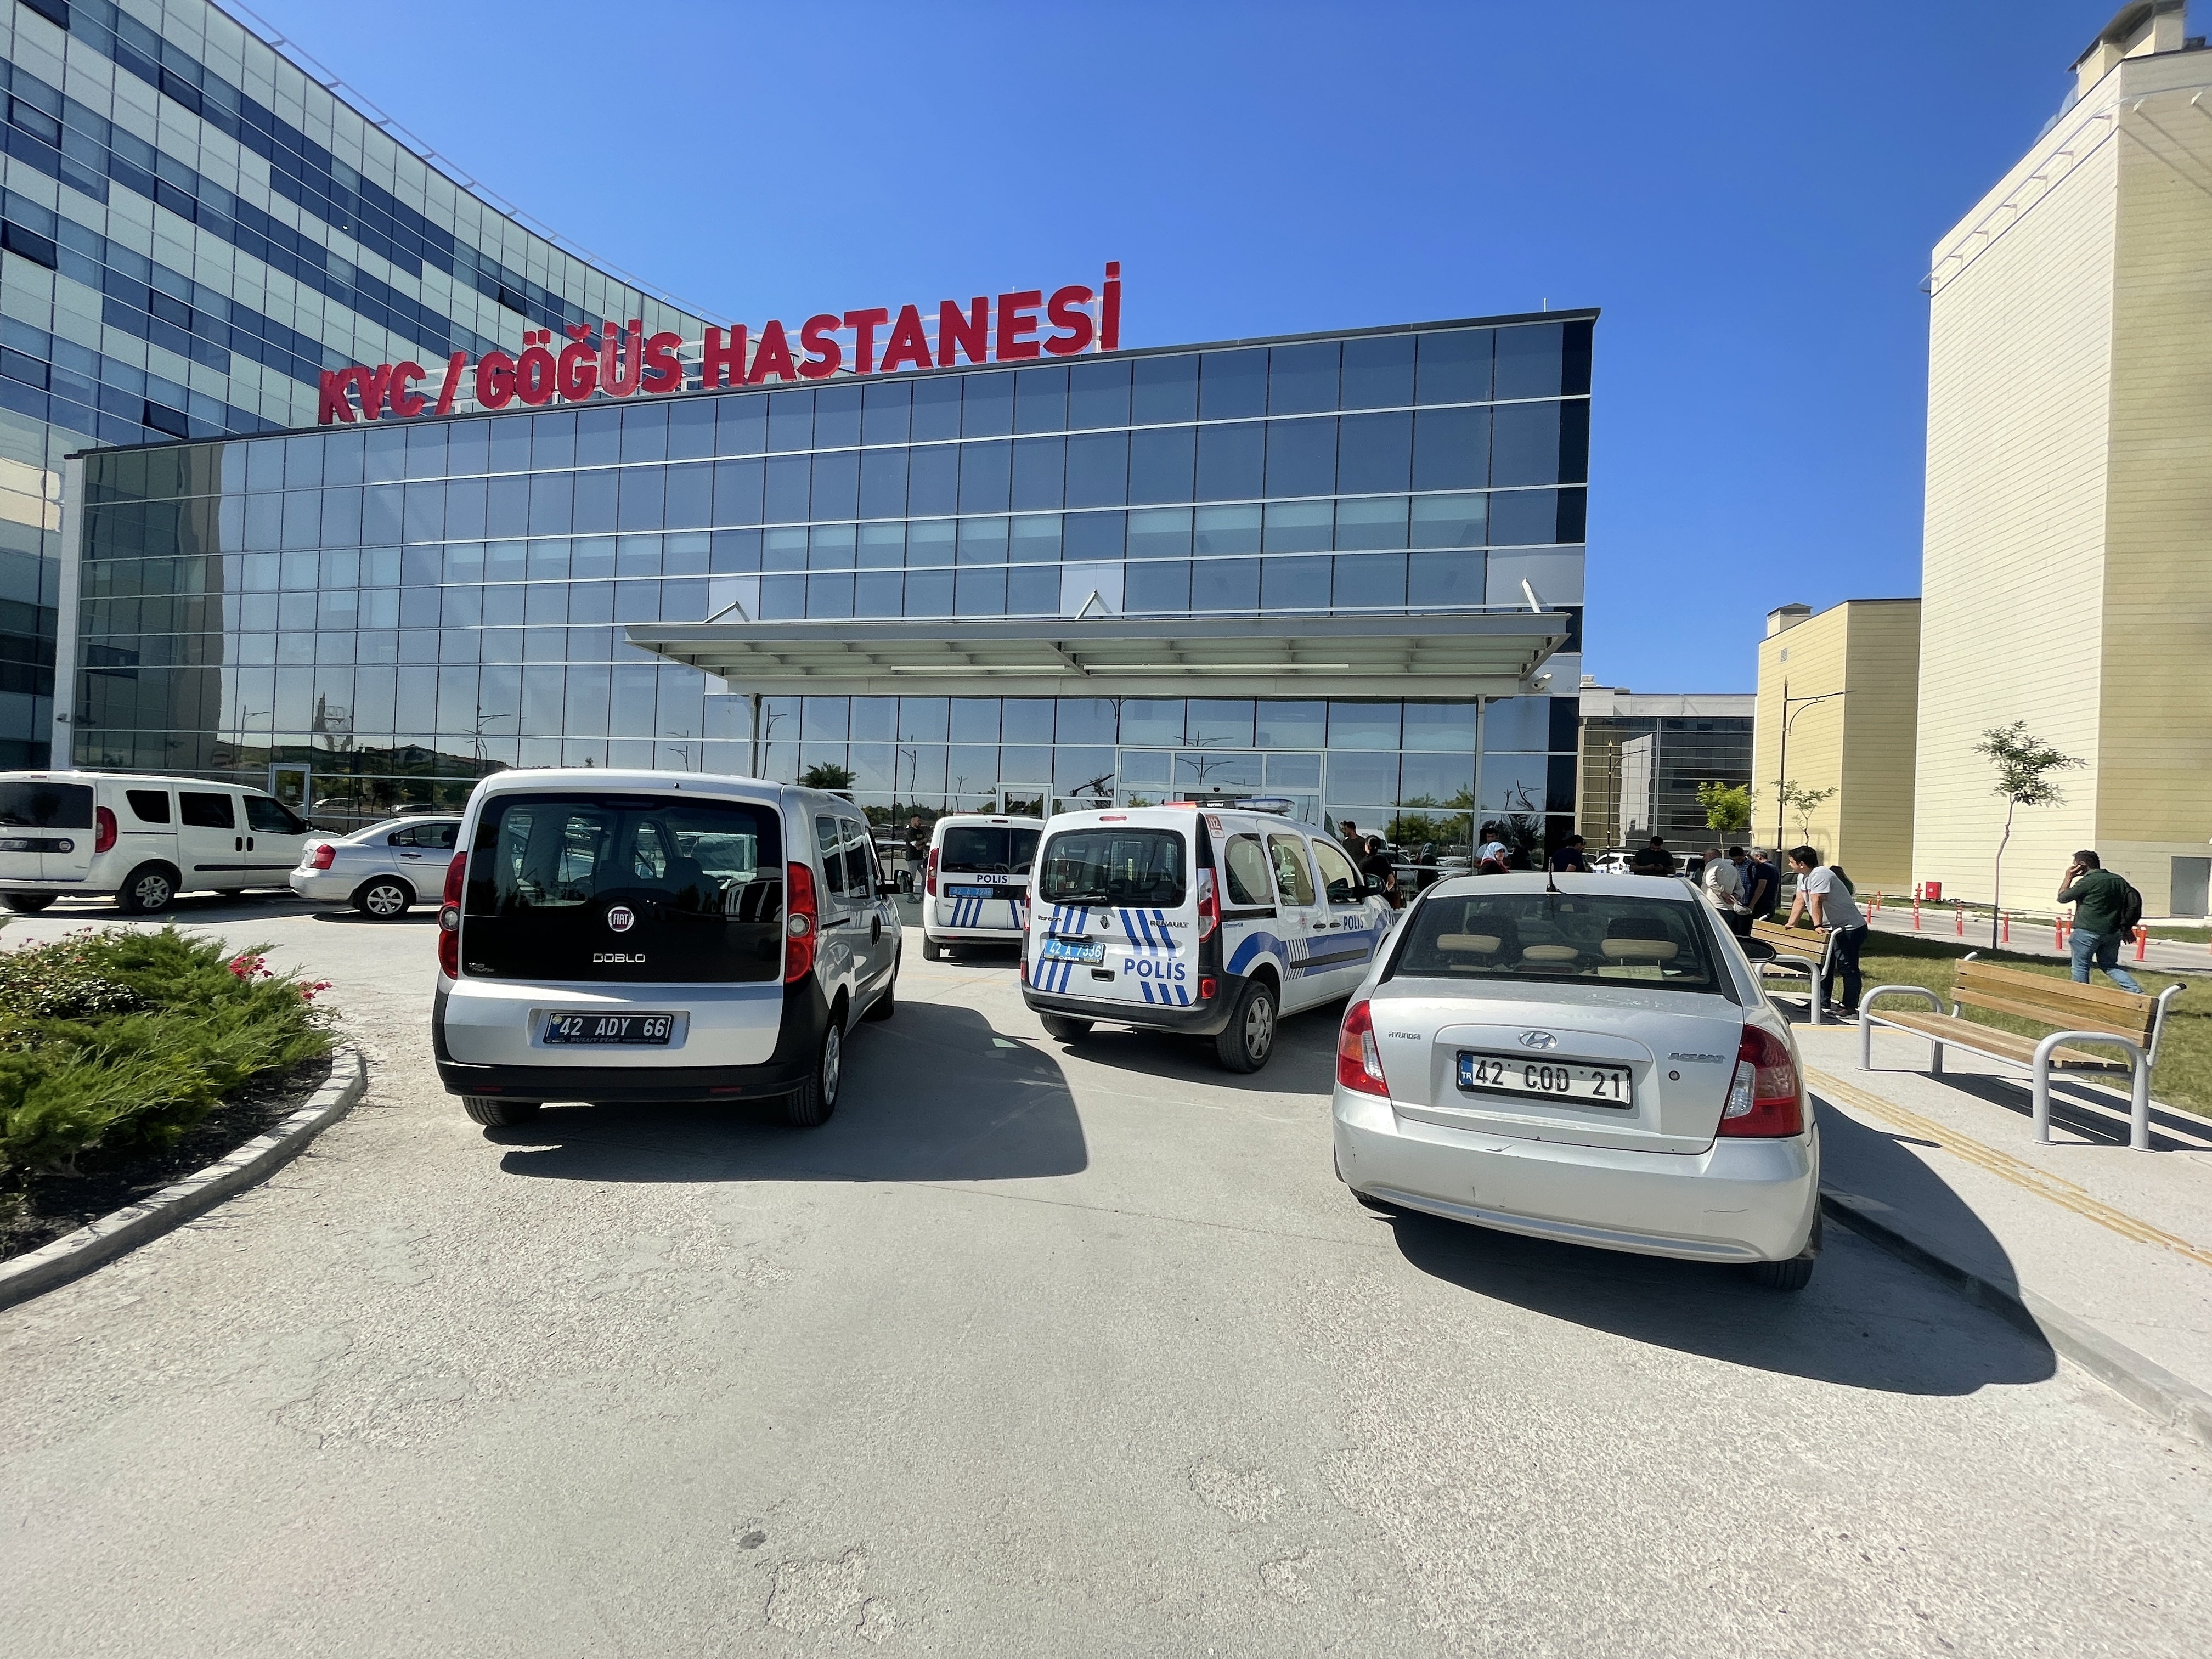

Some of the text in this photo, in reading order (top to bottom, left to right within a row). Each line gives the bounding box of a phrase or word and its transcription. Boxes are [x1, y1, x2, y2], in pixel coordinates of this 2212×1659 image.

[319, 261, 1121, 425] KVC / GÖĞÜS HASTANESİ
[1209, 817, 1220, 829] 112
[613, 913, 629, 925] FIAT
[1150, 920, 1189, 928] RENAULT
[1049, 942, 1101, 958] 42 A 7336
[593, 953, 645, 962] DOBLO
[1124, 958, 1186, 981] POLİS
[560, 1018, 666, 1036] 42 ADY 66
[1388, 1031, 1421, 1040] HYUNDAI
[1462, 1060, 1620, 1098] TR 42 COD 21
